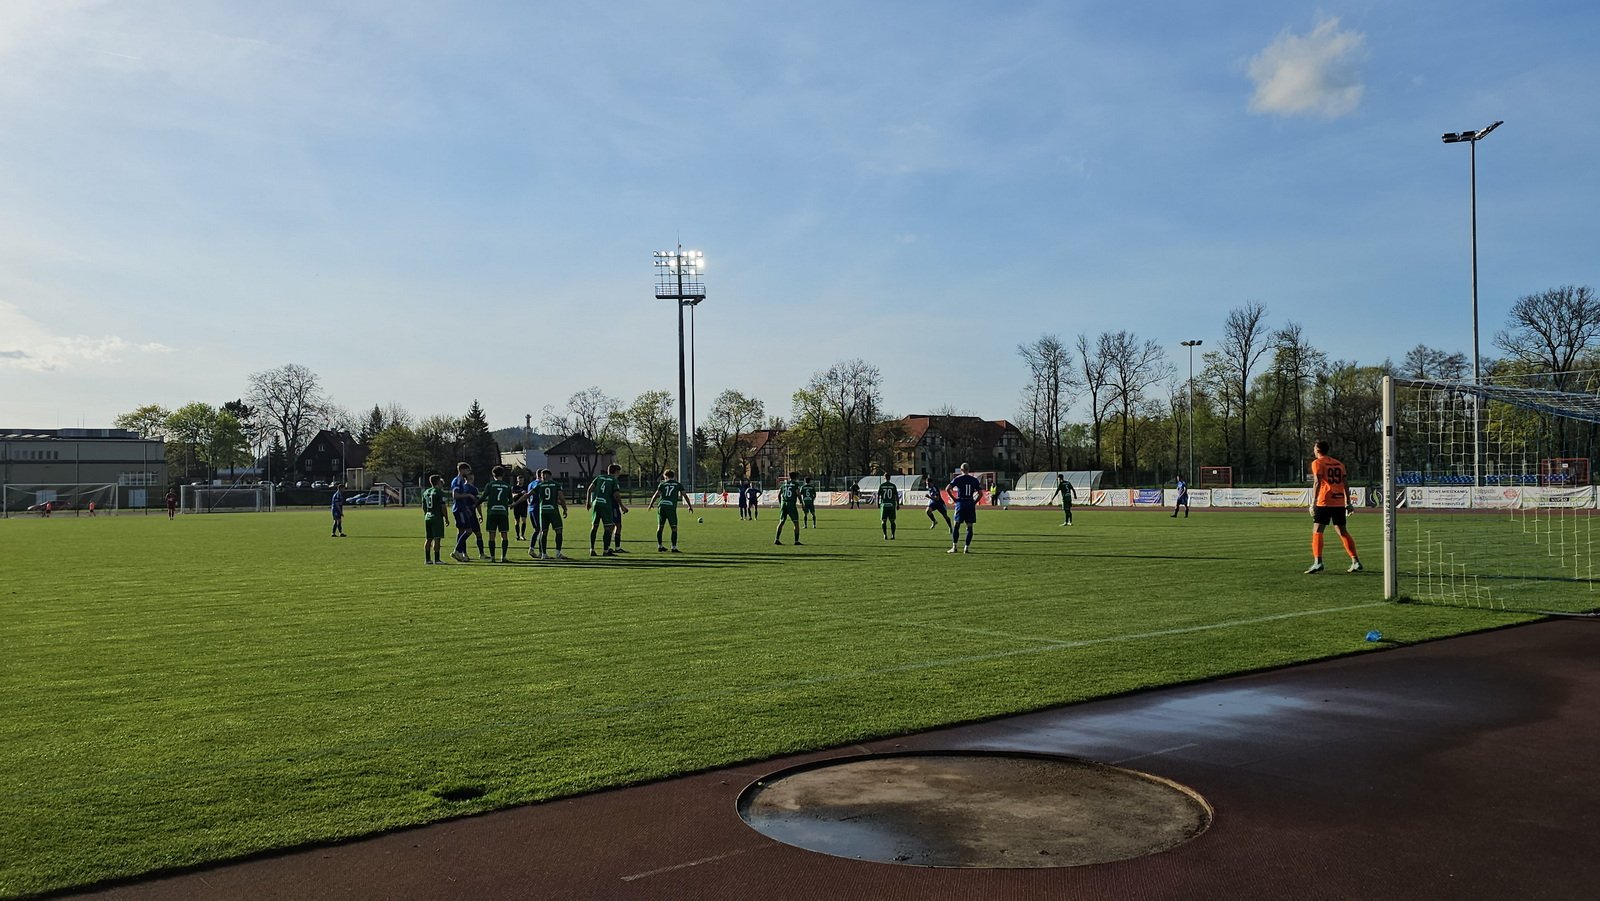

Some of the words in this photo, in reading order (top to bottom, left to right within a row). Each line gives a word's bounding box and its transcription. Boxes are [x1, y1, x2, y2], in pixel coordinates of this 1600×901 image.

[1327, 467, 1342, 484] 99
[496, 487, 503, 501] 7
[544, 487, 551, 501] 9
[600, 480, 606, 494] 4
[664, 485, 675, 497] 17
[805, 488, 811, 497] 6
[882, 488, 893, 500] 70
[965, 483, 971, 497] 11
[1411, 489, 1423, 501] 33
